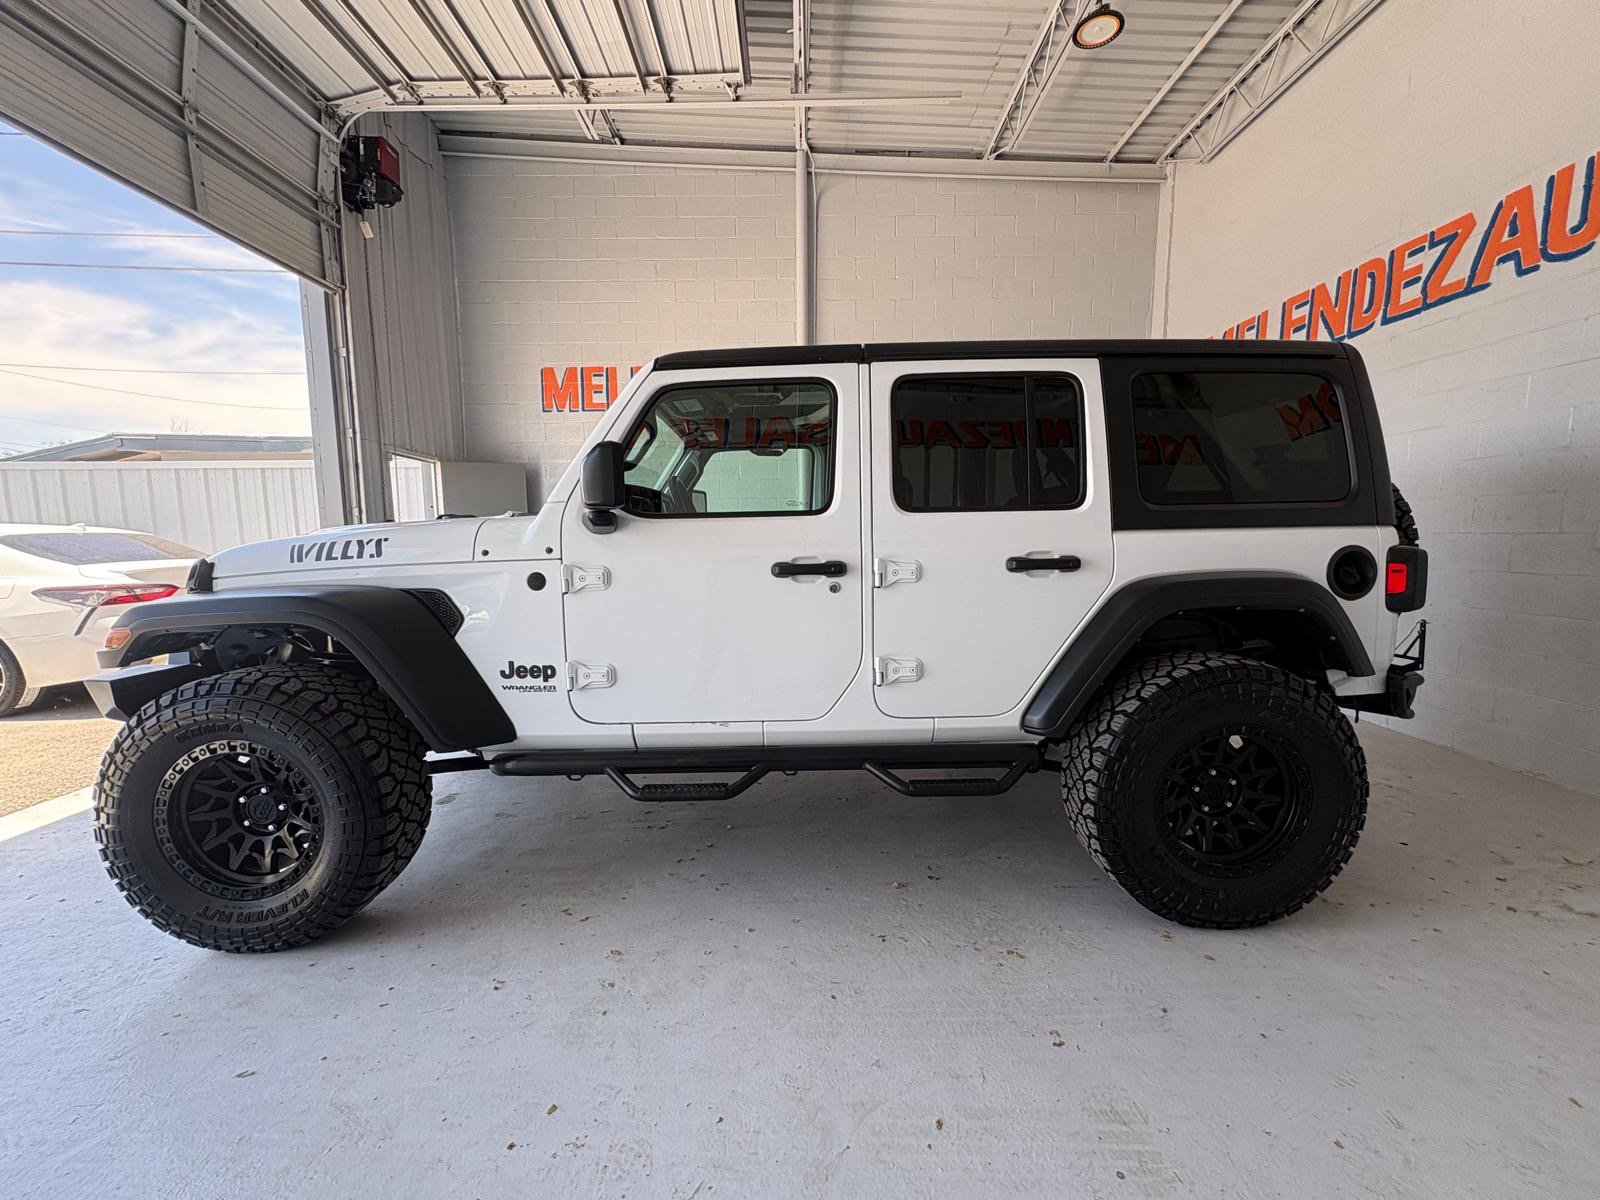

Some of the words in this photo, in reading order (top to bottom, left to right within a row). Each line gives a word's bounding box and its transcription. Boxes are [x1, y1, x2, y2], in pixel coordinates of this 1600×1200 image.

[289, 537, 390, 564] WILLYS
[499, 660, 557, 683] Jeep
[235, 888, 309, 924] KLEVER
